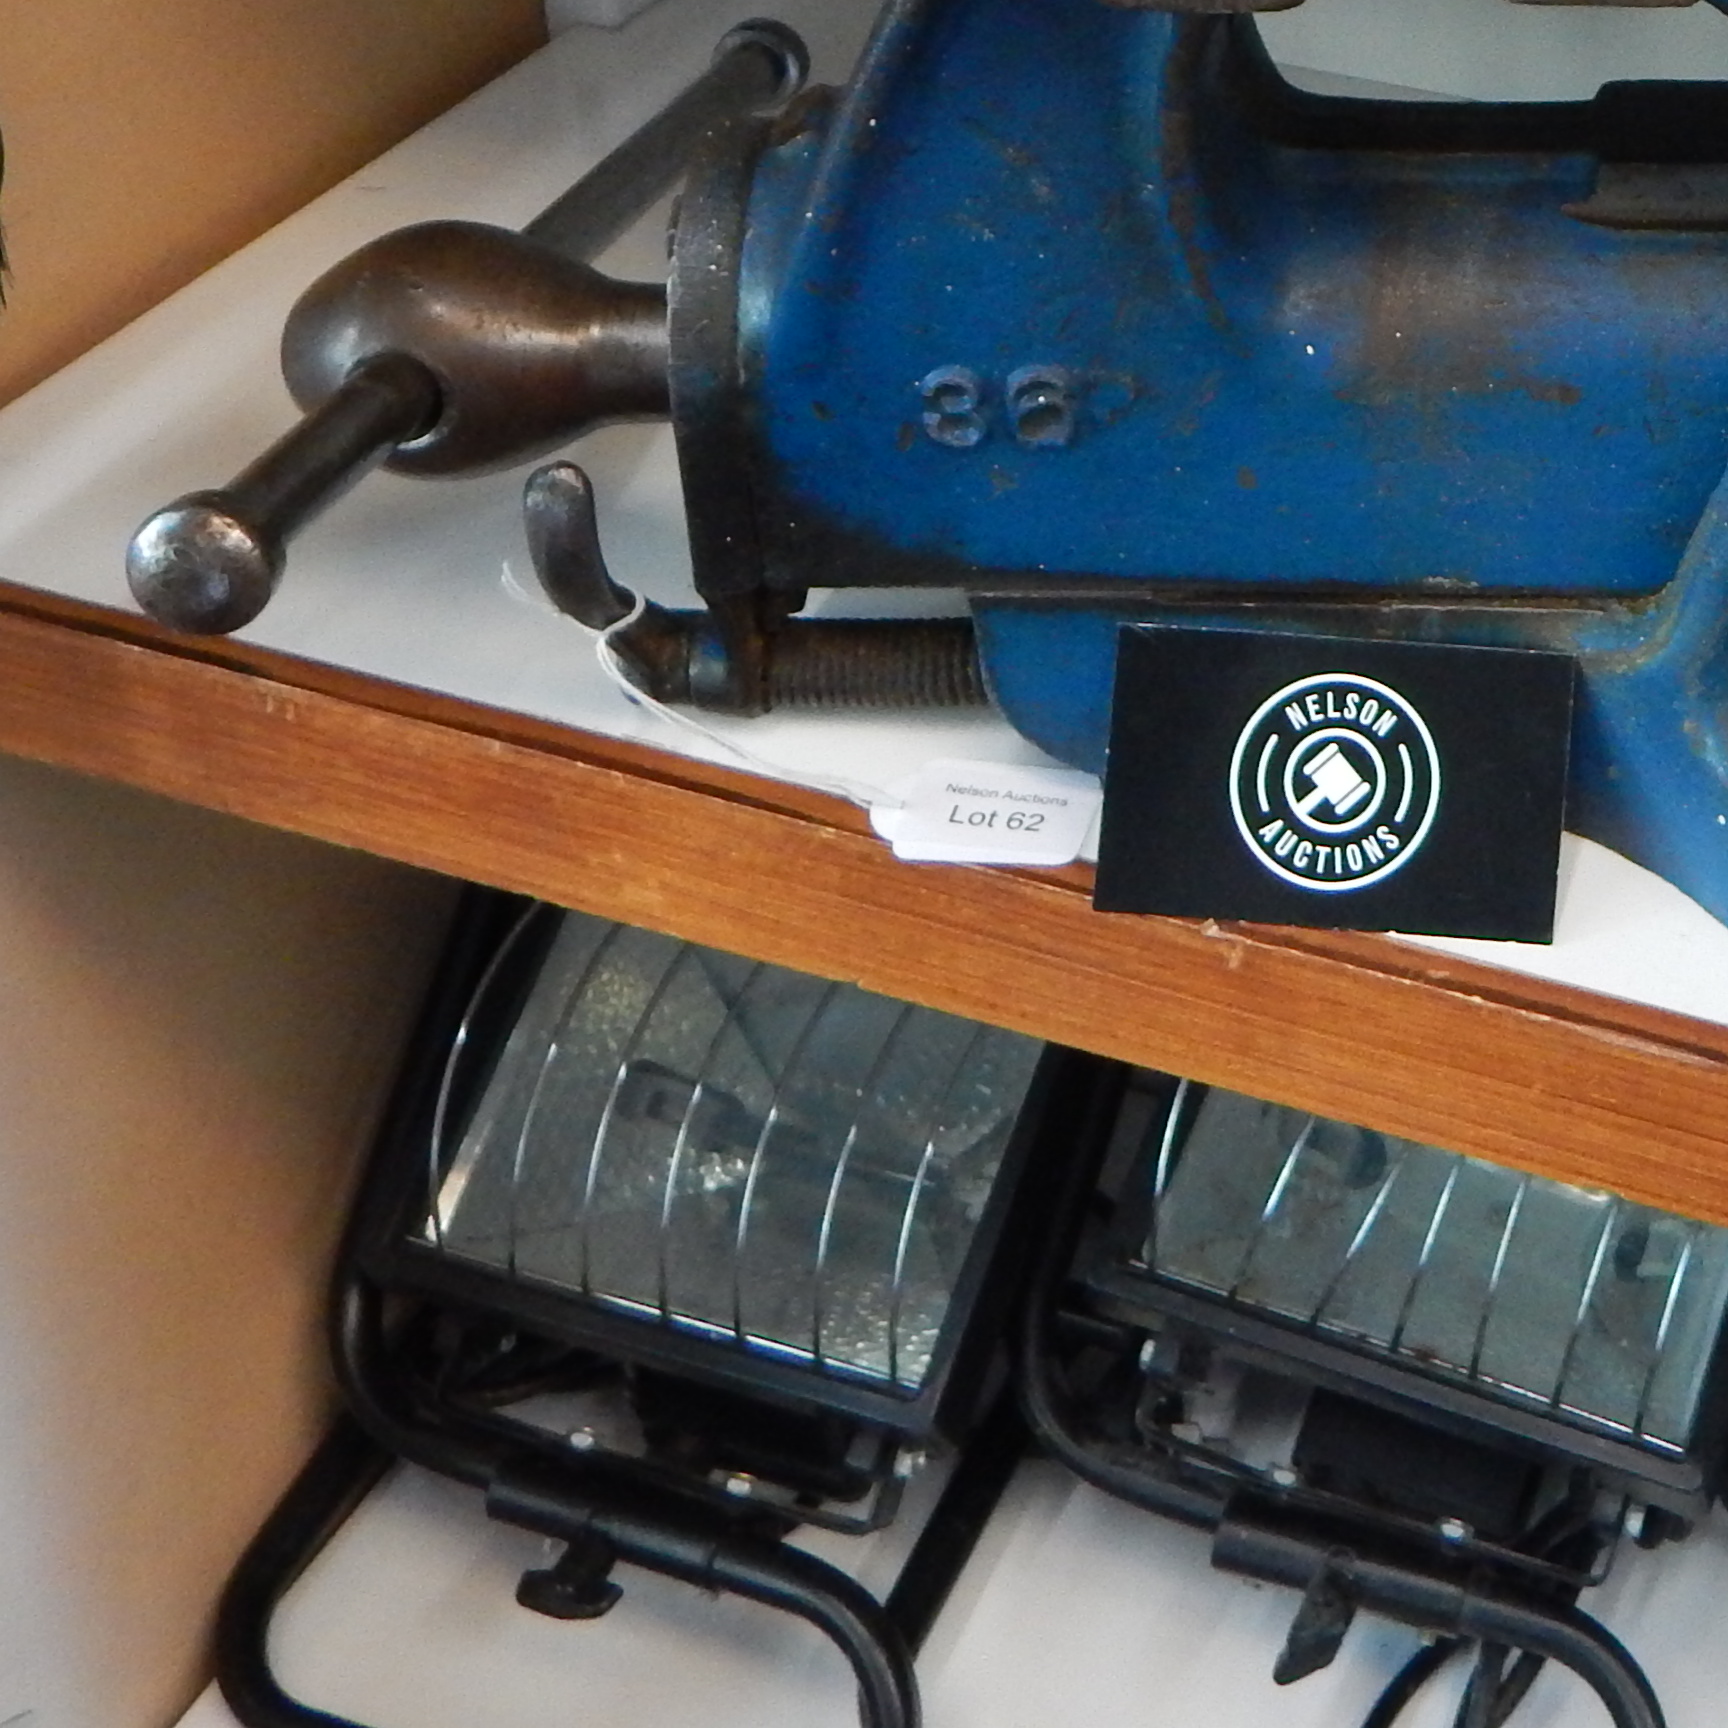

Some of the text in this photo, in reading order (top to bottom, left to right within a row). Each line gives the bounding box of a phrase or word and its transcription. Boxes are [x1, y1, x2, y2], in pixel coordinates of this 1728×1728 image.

[921, 363, 1074, 448] 36
[1284, 690, 1398, 738] NELSON
[945, 782, 1069, 807] Nelson Auctions
[948, 804, 1046, 832] Lot 62
[1258, 819, 1400, 875] AUCTIONS
